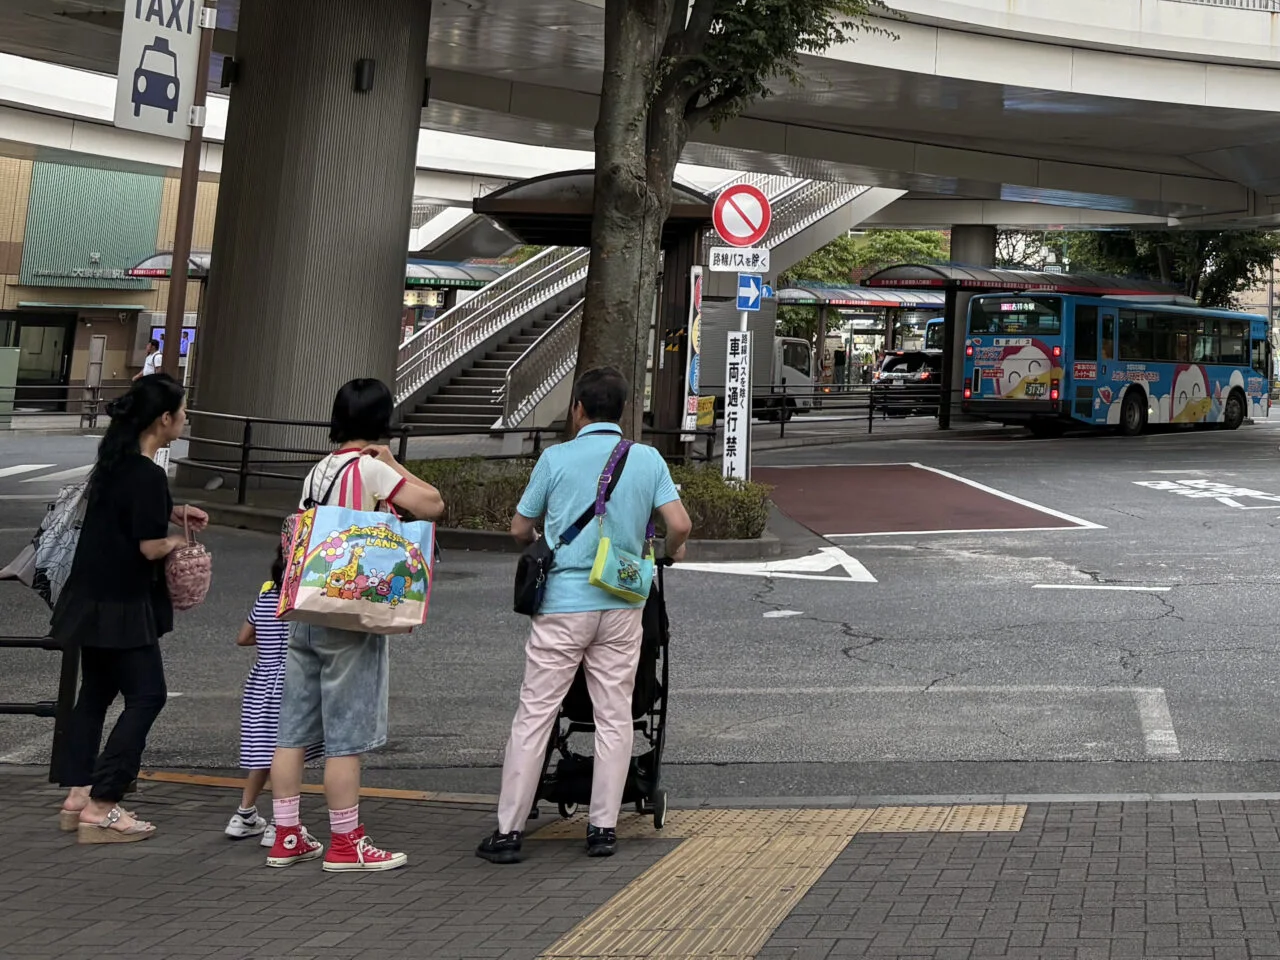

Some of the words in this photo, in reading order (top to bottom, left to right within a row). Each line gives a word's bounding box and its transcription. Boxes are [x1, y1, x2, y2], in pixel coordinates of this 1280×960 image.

[713, 252, 766, 268] 路線バスを除く
[739, 333, 749, 409] 路線バスを除く
[725, 336, 741, 478] 車両通行禁止
[366, 537, 398, 549] LAND
